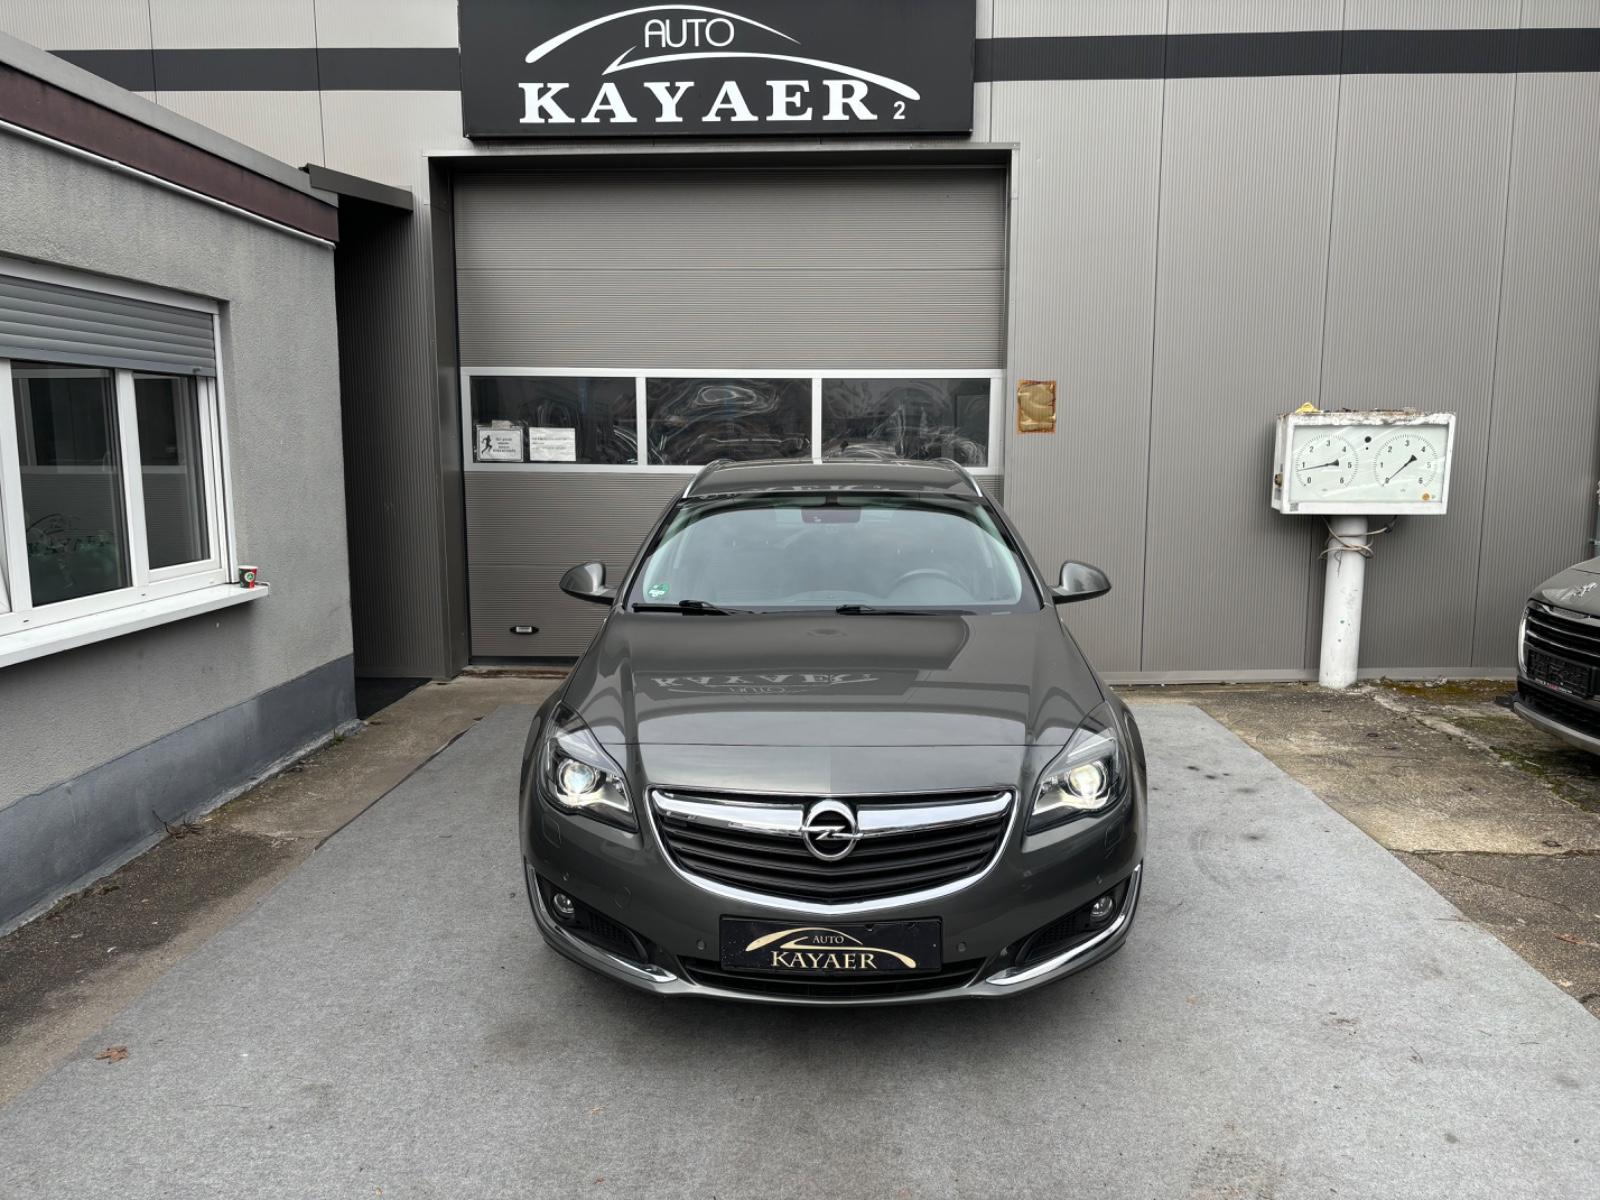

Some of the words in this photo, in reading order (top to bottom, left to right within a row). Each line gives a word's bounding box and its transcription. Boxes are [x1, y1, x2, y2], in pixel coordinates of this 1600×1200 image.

[644, 18, 735, 48] AUTO
[518, 80, 878, 124] KAYAER
[893, 101, 906, 120] 2
[1325, 439, 1331, 447] 3
[1309, 445, 1314, 453] 2
[1347, 461, 1352, 469] 5
[1387, 445, 1393, 453] 2
[1404, 439, 1410, 447] 3
[1418, 477, 1423, 485] 6
[1307, 476, 1312, 484] 0
[1339, 476, 1344, 484] 6
[812, 936, 844, 944] AUTO
[770, 951, 878, 970] KAYAER
